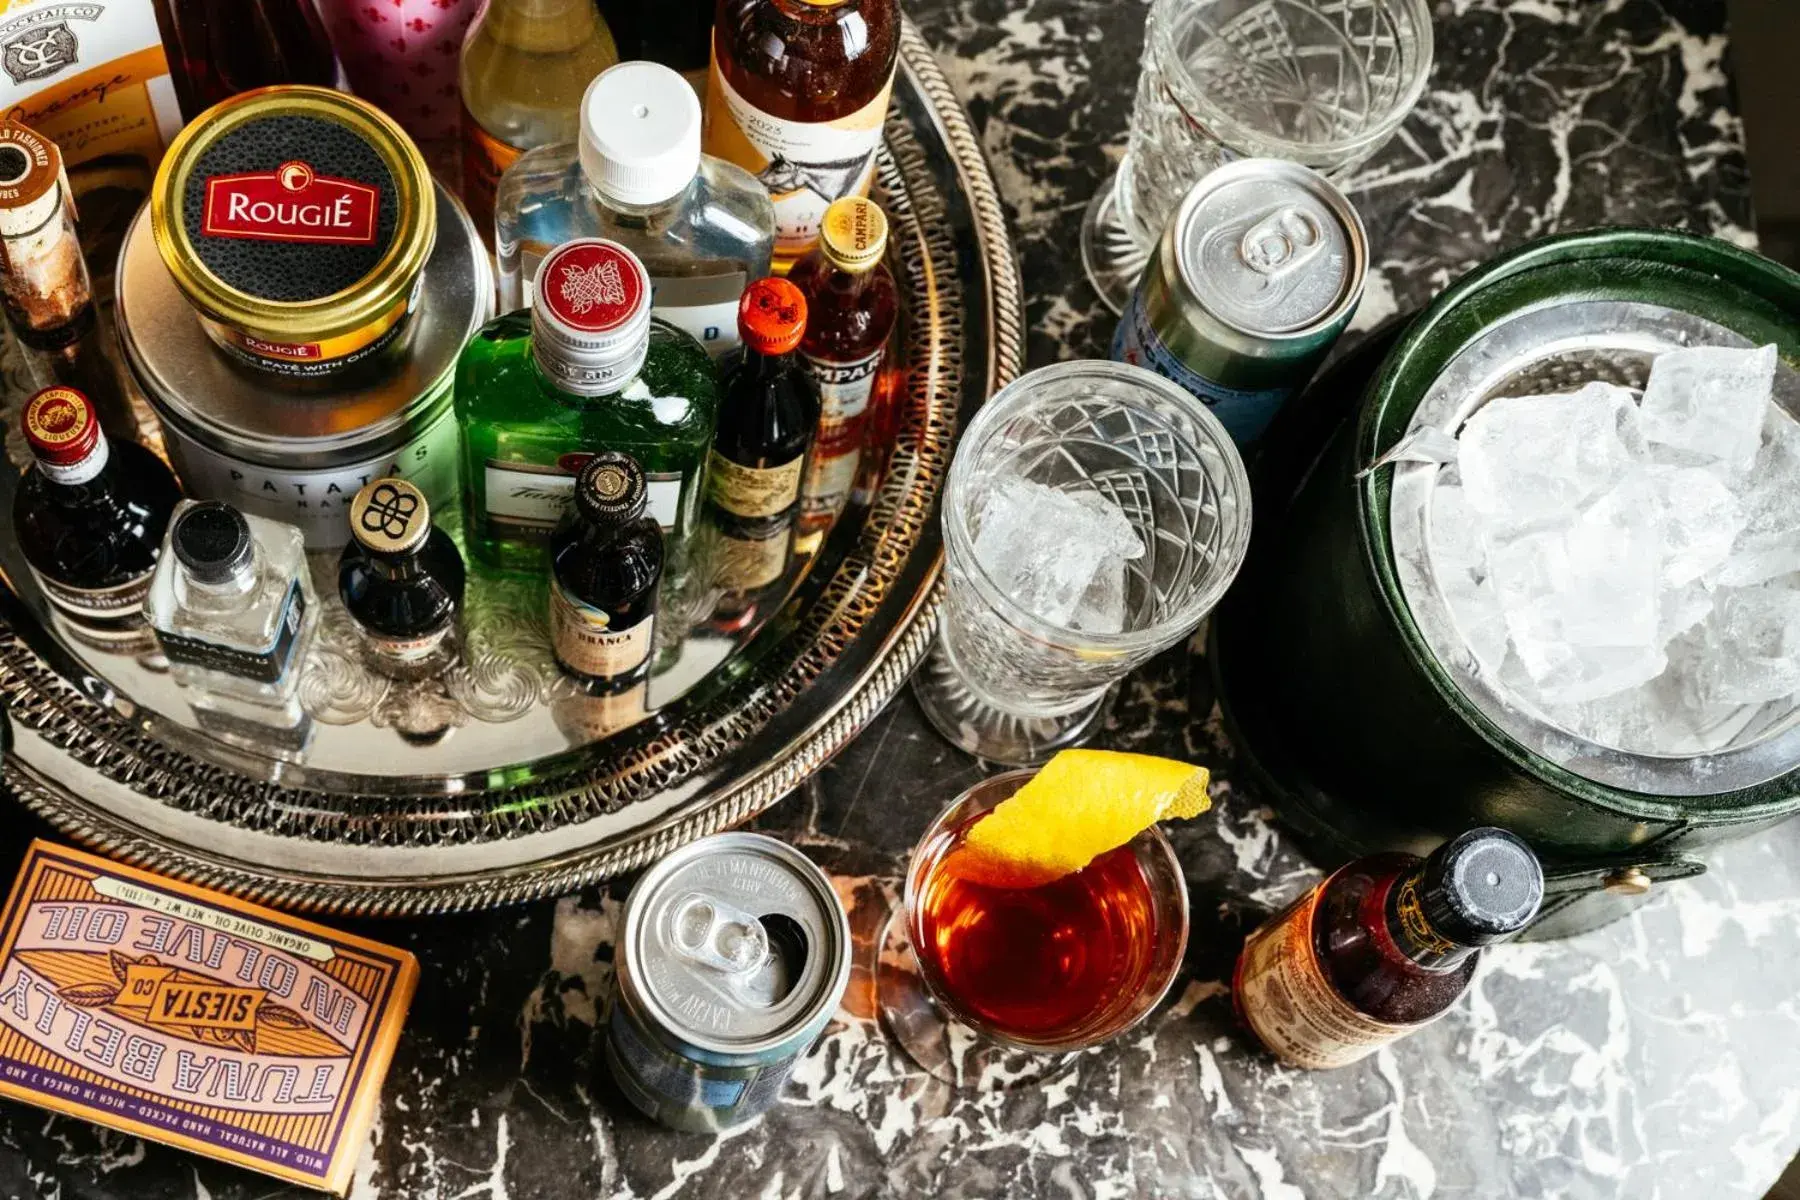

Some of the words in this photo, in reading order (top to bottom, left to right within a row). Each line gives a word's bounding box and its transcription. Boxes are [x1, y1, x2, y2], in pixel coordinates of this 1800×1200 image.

[13, 130, 48, 167] FASHIONED
[855, 203, 867, 250] CAMPARI
[304, 361, 342, 371] WITH
[582, 367, 613, 380] GIN
[814, 357, 880, 382] MPAR
[186, 909, 203, 921] NET
[215, 917, 231, 928] OIL
[39, 906, 128, 944] OIL
[233, 923, 264, 938] OLIVE
[266, 933, 311, 953] ORGANIC
[133, 915, 298, 998] OLIVE
[162, 989, 253, 1022] SIESTA
[302, 976, 356, 1035] IN
[0, 971, 167, 1082] BELLY
[6, 1067, 28, 1080] AND
[31, 1073, 39, 1082] 3
[174, 1050, 336, 1104] TUNA
[42, 1076, 80, 1095] OMEGA
[84, 1090, 95, 1099] IN
[100, 1094, 126, 1109] HIGH
[138, 1106, 178, 1125] PACKED
[182, 1119, 211, 1136] HAND
[270, 1149, 287, 1160] ALL
[294, 1151, 324, 1170] WILD.
